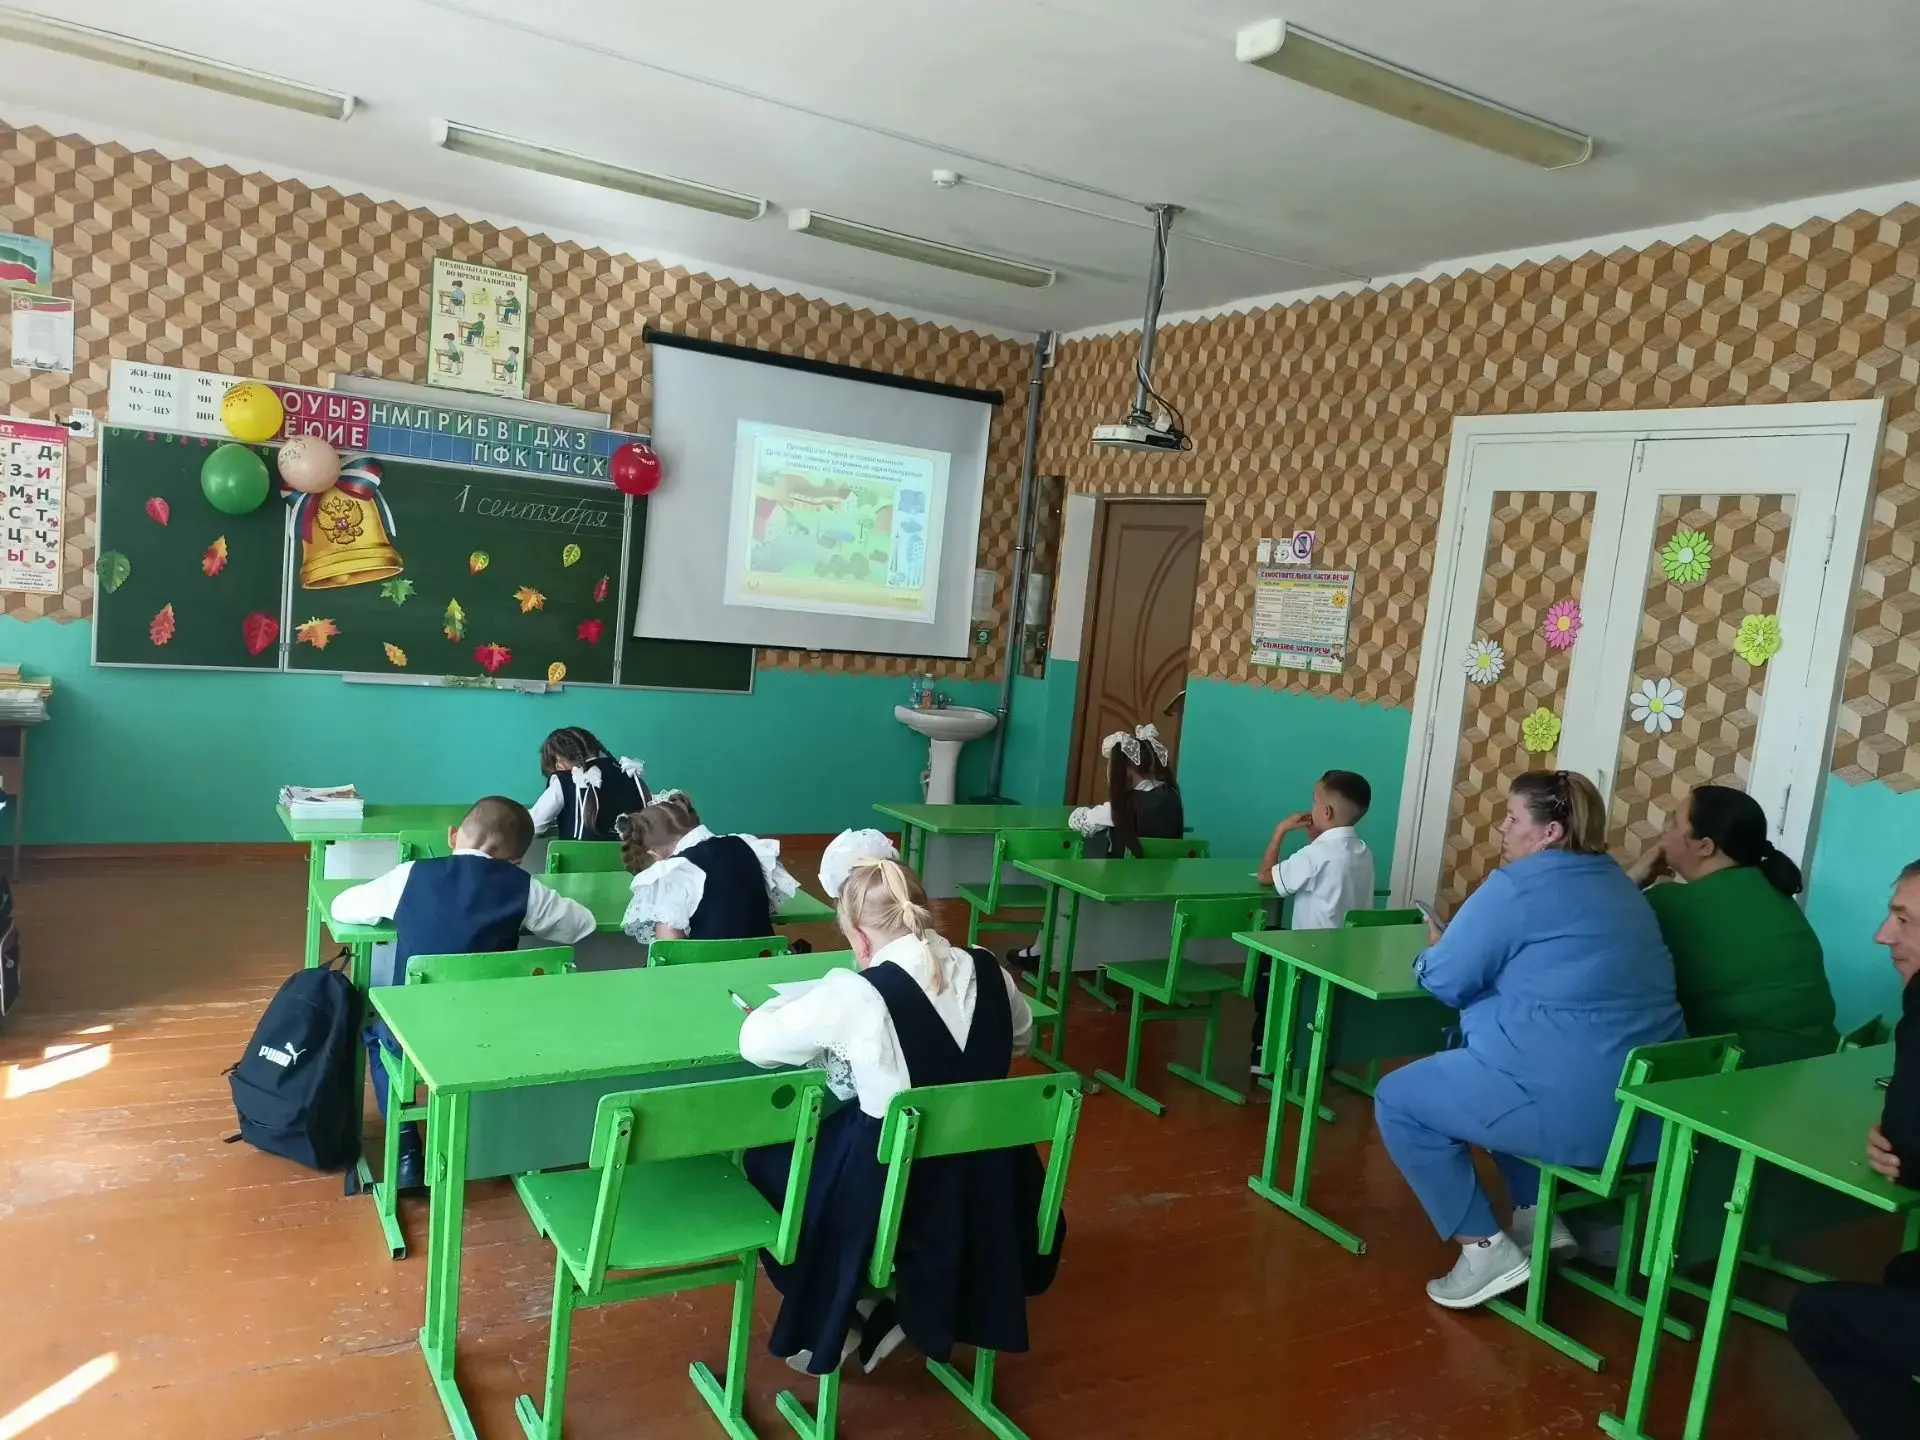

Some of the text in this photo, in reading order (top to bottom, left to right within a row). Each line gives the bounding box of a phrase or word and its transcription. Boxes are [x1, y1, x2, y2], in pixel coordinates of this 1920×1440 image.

[440, 261, 522, 281] ПРАВИЛЬНАЯ ПОСАДКА
[457, 272, 480, 281] ВРЕМЯ
[198, 378, 212, 387] ЧК
[283, 392, 586, 450] О У Ы Э Н М Л Р Й Б В Г Д Ж З
[11, 442, 52, 460] Г Д
[285, 416, 297, 438] Ё
[328, 424, 343, 444] И
[351, 427, 363, 447] Е
[474, 443, 488, 461] П
[493, 445, 509, 463] Ф
[515, 448, 527, 467] К
[536, 451, 548, 468] Т
[552, 452, 568, 472] Ш
[573, 455, 585, 474] С
[591, 457, 604, 477] Х
[10, 464, 50, 479] З И
[10, 486, 49, 500] М Н
[9, 507, 48, 521] С Т
[455, 485, 608, 535] 1 сентября
[8, 528, 47, 543] Ц Ч
[8, 549, 46, 563] Ы Ь
